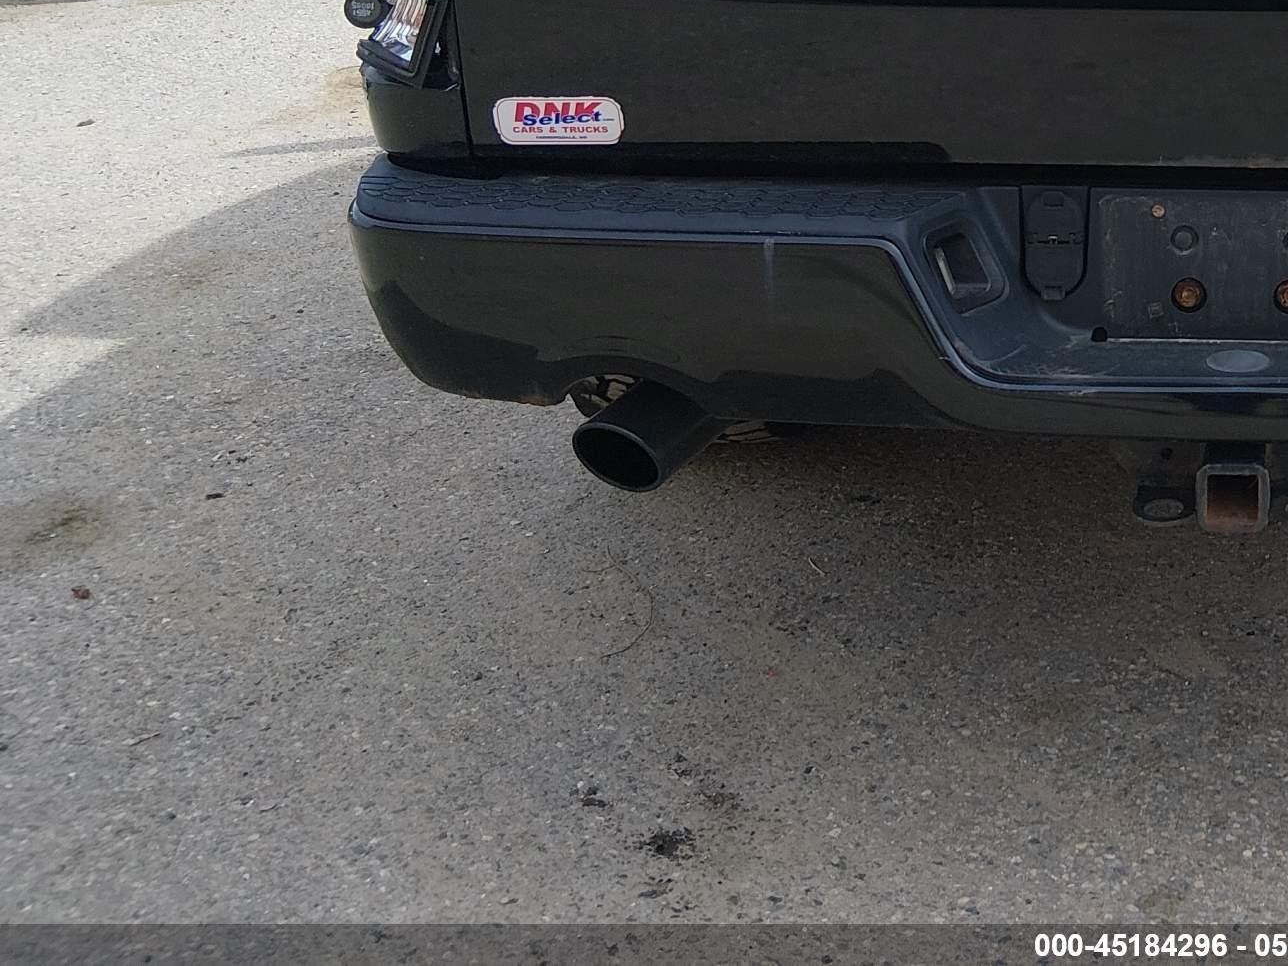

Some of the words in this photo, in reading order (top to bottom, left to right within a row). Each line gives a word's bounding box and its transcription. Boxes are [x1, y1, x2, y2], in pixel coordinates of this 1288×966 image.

[514, 102, 603, 123] DNK
[522, 111, 602, 126] Select
[512, 126, 544, 134] CARS
[561, 126, 609, 134] TRUCKS
